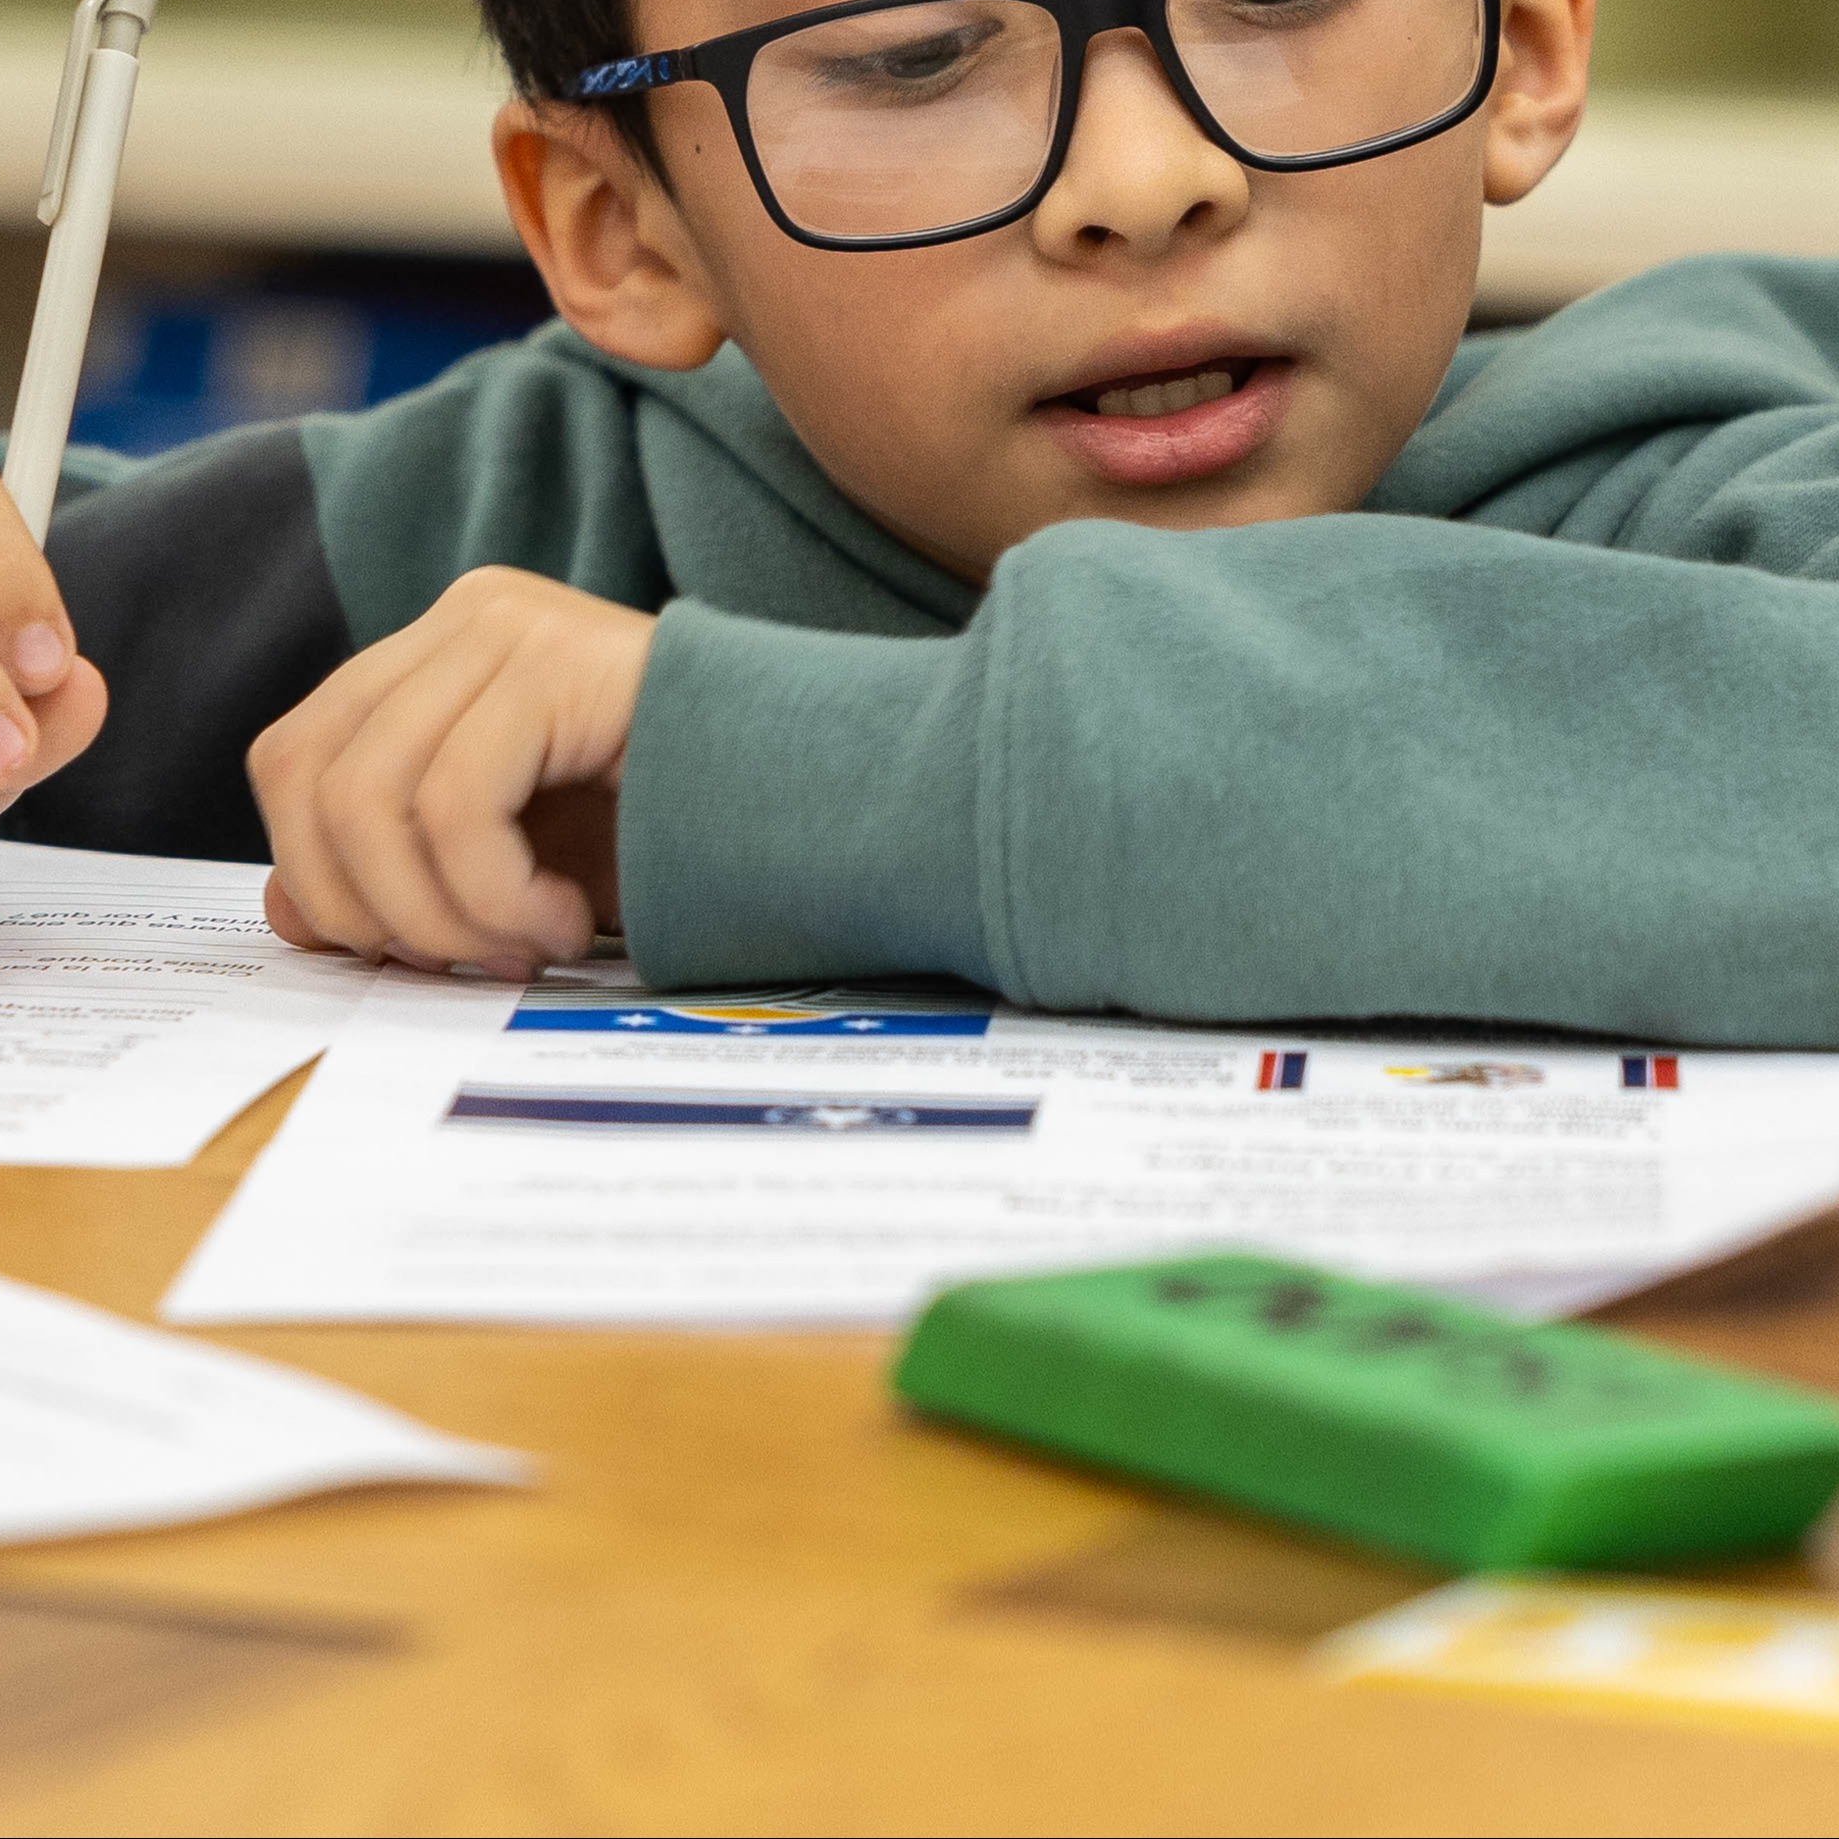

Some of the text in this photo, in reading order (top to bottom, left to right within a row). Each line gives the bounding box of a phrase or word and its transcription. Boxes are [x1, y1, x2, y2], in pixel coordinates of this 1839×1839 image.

[97, 912, 155, 920] por
[162, 913, 182, 921] y
[77, 920, 137, 928] que
[36, 956, 153, 965] porque
[100, 964, 162, 973] que
[174, 968, 253, 978] Creo
